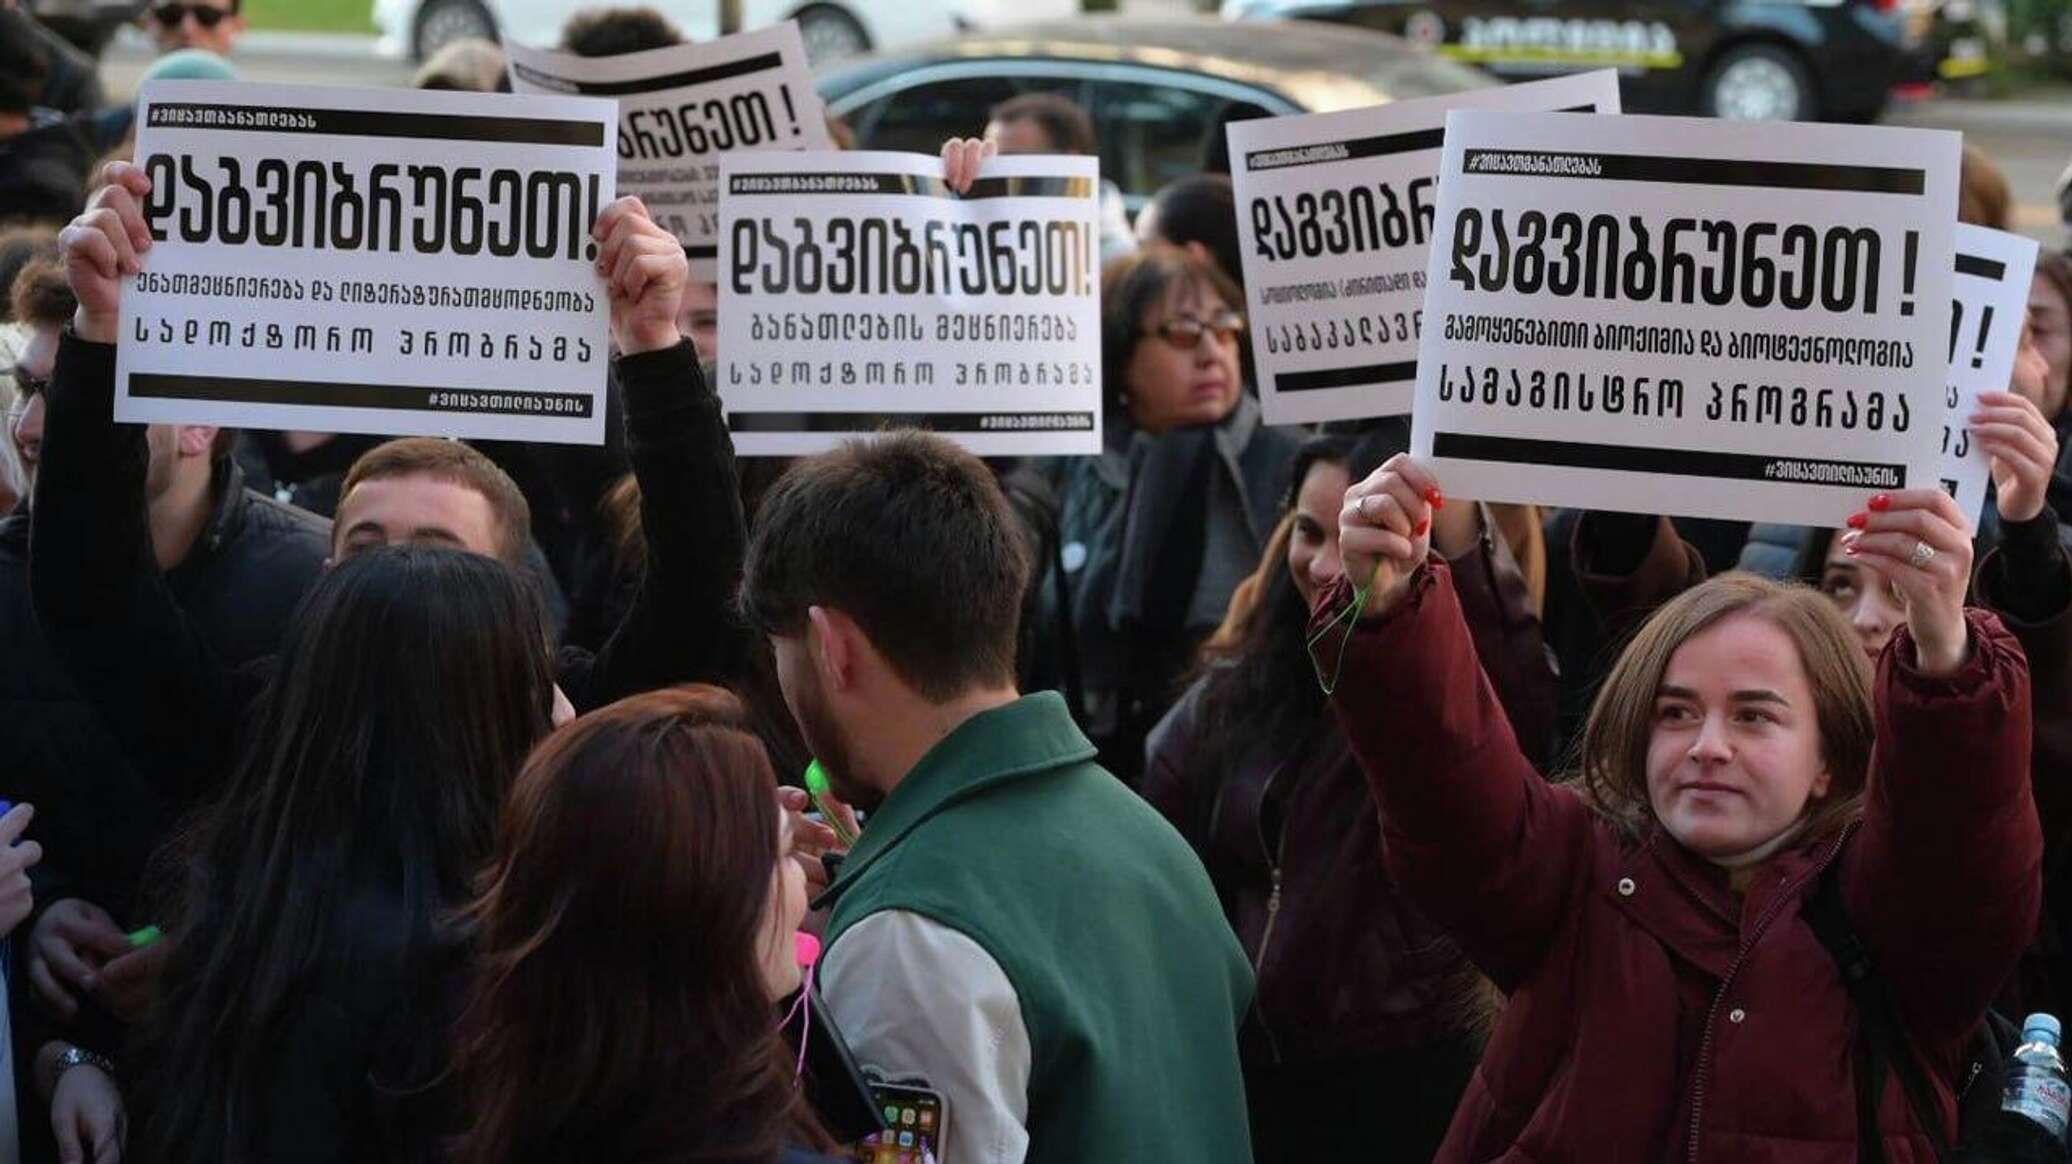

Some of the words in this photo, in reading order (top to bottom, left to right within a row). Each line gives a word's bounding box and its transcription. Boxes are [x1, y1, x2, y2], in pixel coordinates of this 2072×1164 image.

[144, 154, 601, 260] დაგვიბრუნეთ!
[136, 270, 304, 300] ენათმეცნიერება
[312, 280, 332, 301] და
[340, 282, 594, 313] ლიტერატურათმცოდნეობა
[136, 317, 373, 353] სადოქტორო
[400, 330, 591, 362] პროგრამა
[751, 313, 923, 340] განათლების
[936, 313, 1078, 341] მეცნიერება
[1445, 314, 1588, 349] გამოყენებითი
[1594, 324, 1694, 355] ბიოქიმია
[1701, 330, 1722, 357] და
[1728, 332, 1913, 368] ბიოტექნოლოგია
[730, 361, 933, 385] სადოქტორო
[955, 362, 1093, 386] პროგრამა
[1440, 365, 1683, 418] სამაგისტრო
[1706, 382, 1909, 432] პროგრამა
